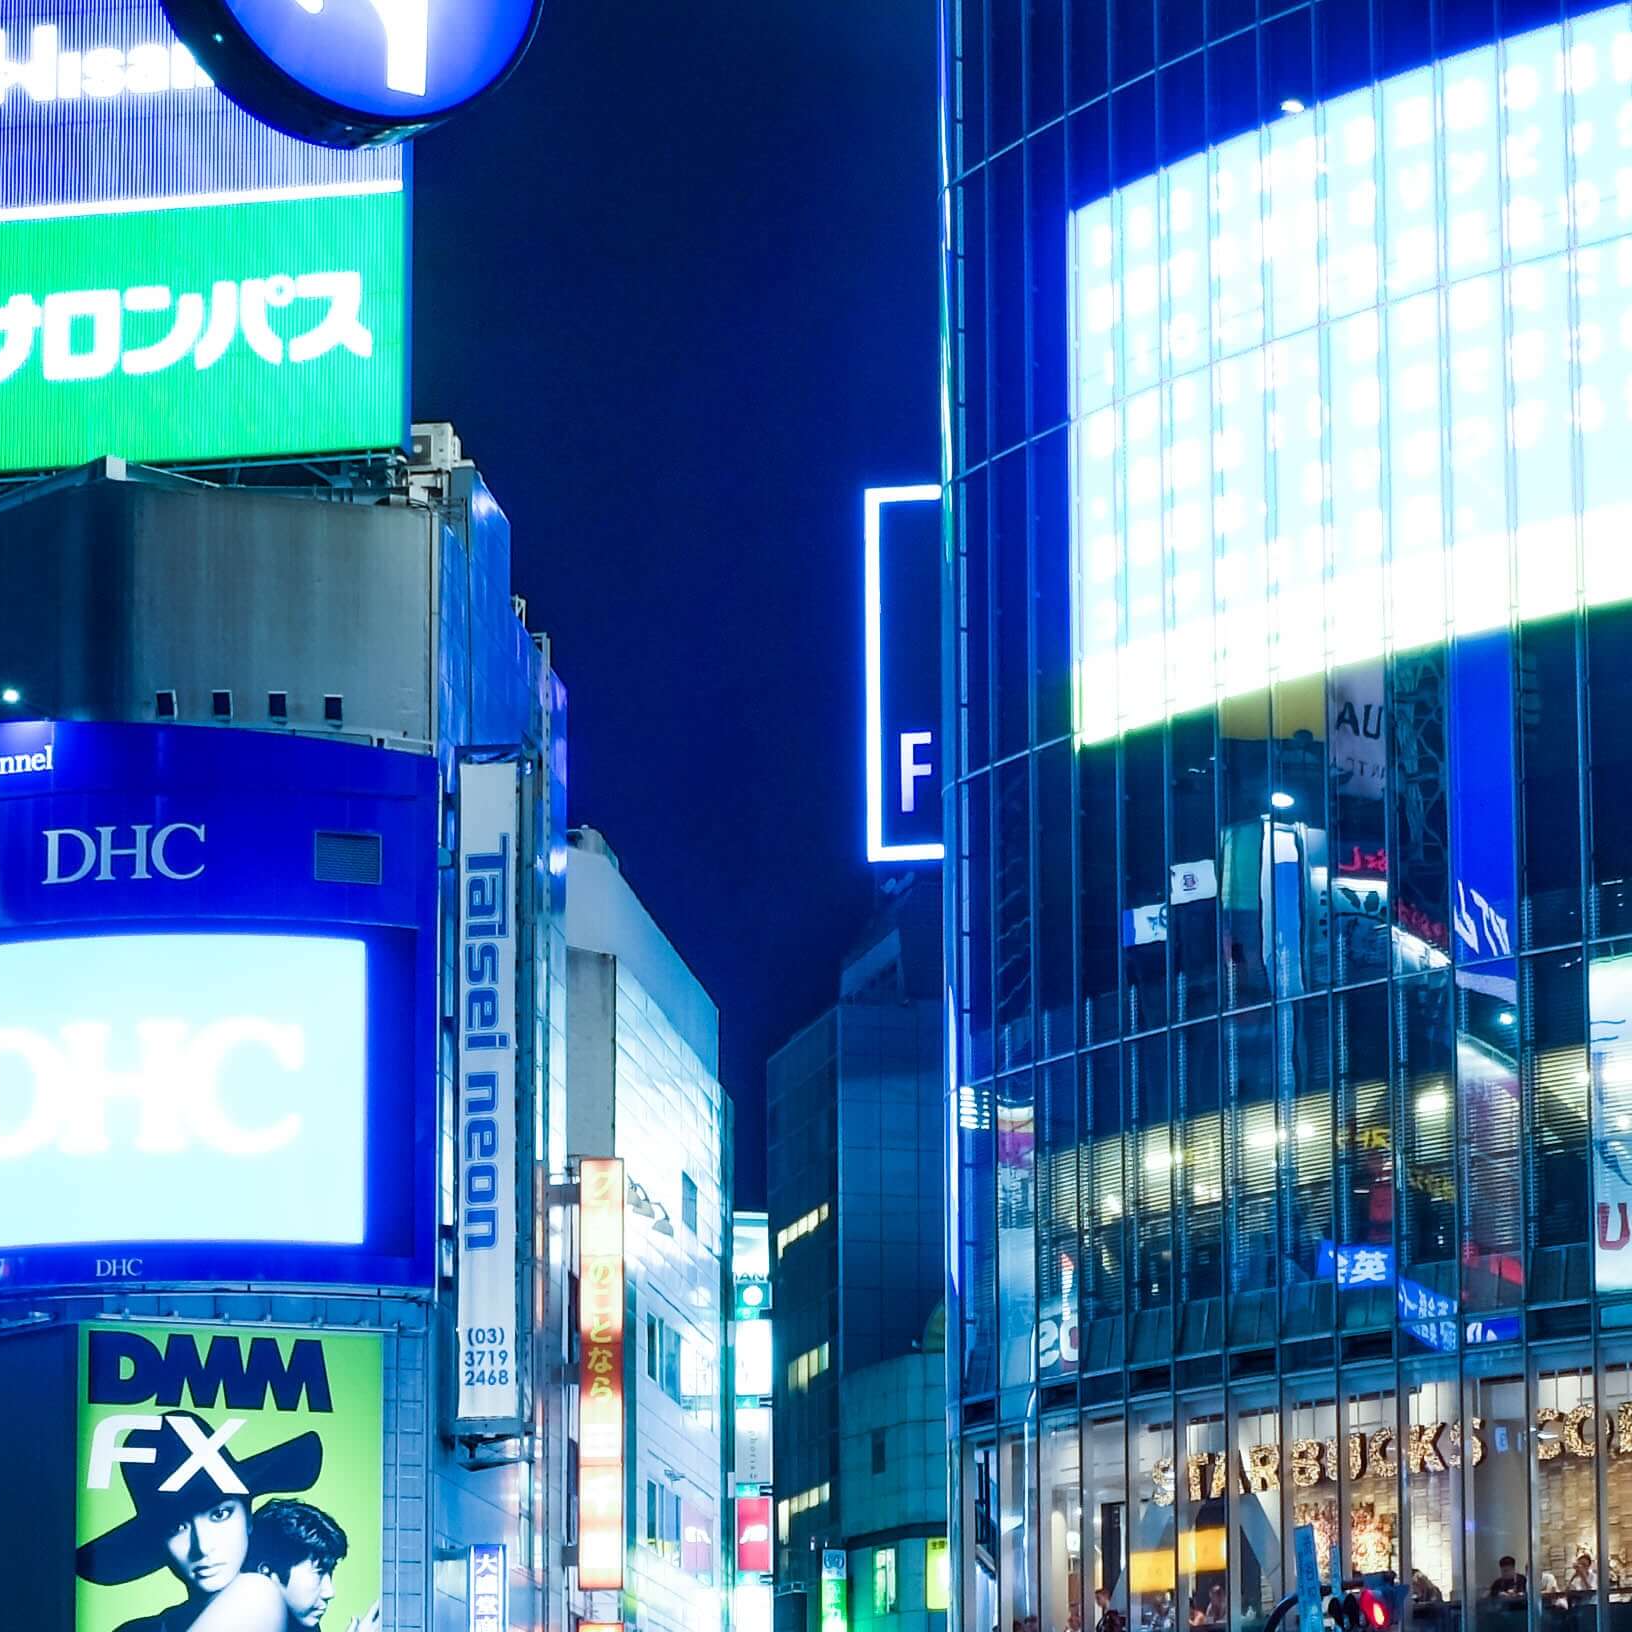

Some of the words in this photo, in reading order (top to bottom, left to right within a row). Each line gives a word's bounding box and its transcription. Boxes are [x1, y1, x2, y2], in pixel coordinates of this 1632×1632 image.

[41, 823, 207, 887] DHC
[466, 831, 510, 1051] Taisei
[463, 1071, 498, 1252] neon
[95, 1257, 143, 1277] DHC
[87, 1330, 333, 1413] DMM
[464, 1349, 509, 1369] 3719
[466, 1326, 506, 1348] (03)
[464, 1368, 510, 1389] 2468
[86, 1414, 250, 1495] FX
[1151, 1416, 1488, 1507] STARBUCKS
